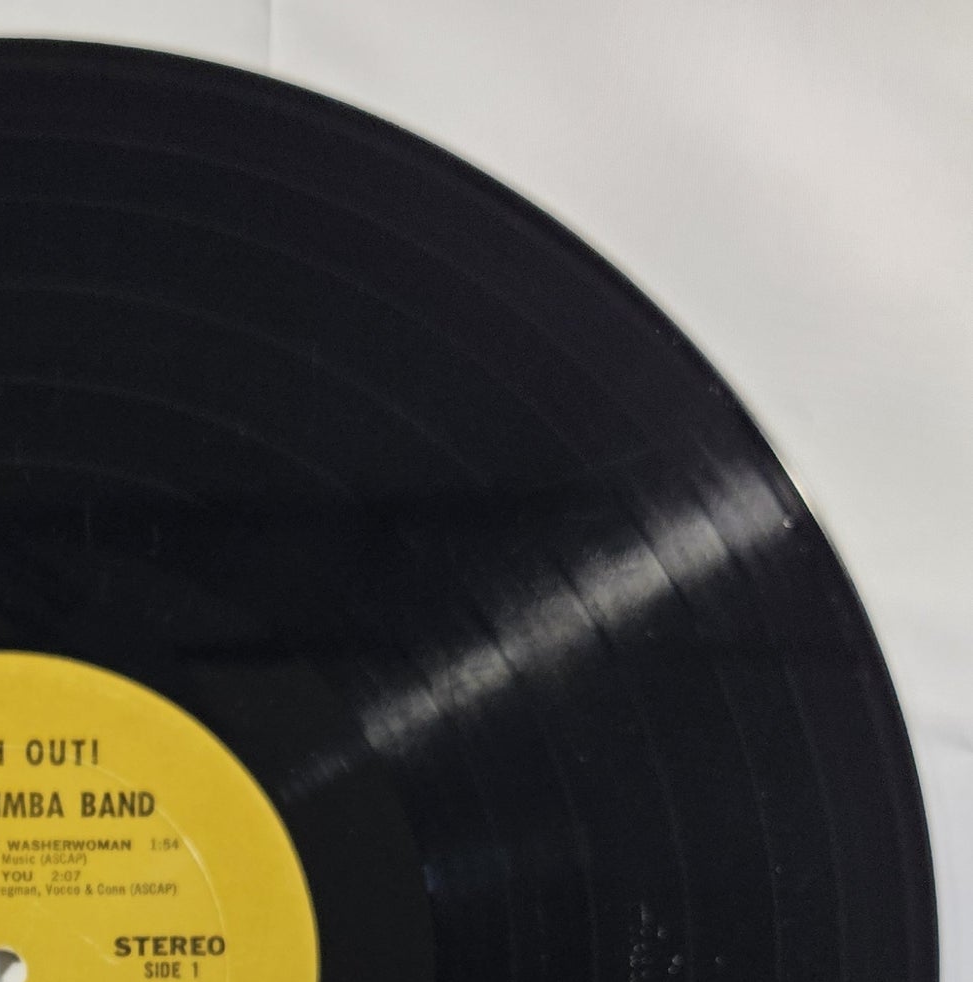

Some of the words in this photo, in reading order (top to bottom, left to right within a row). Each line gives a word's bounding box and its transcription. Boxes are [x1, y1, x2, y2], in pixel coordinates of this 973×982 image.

[25, 738, 98, 765] OUT!
[81, 790, 155, 818] BAND
[7, 839, 131, 852] WASHERWOMAN
[151, 839, 179, 851] 1:54
[2, 854, 35, 866] Music
[40, 853, 87, 865] (ASCAP)
[2, 870, 33, 882] YOU
[51, 870, 81, 882] 2:07
[46, 883, 80, 896] Vocco
[85, 883, 93, 896] &
[97, 883, 125, 896] Conn
[131, 882, 177, 896] (ASCAP)
[114, 936, 226, 957] STEREO
[144, 962, 181, 979] SIDE
[193, 962, 198, 979] 1
